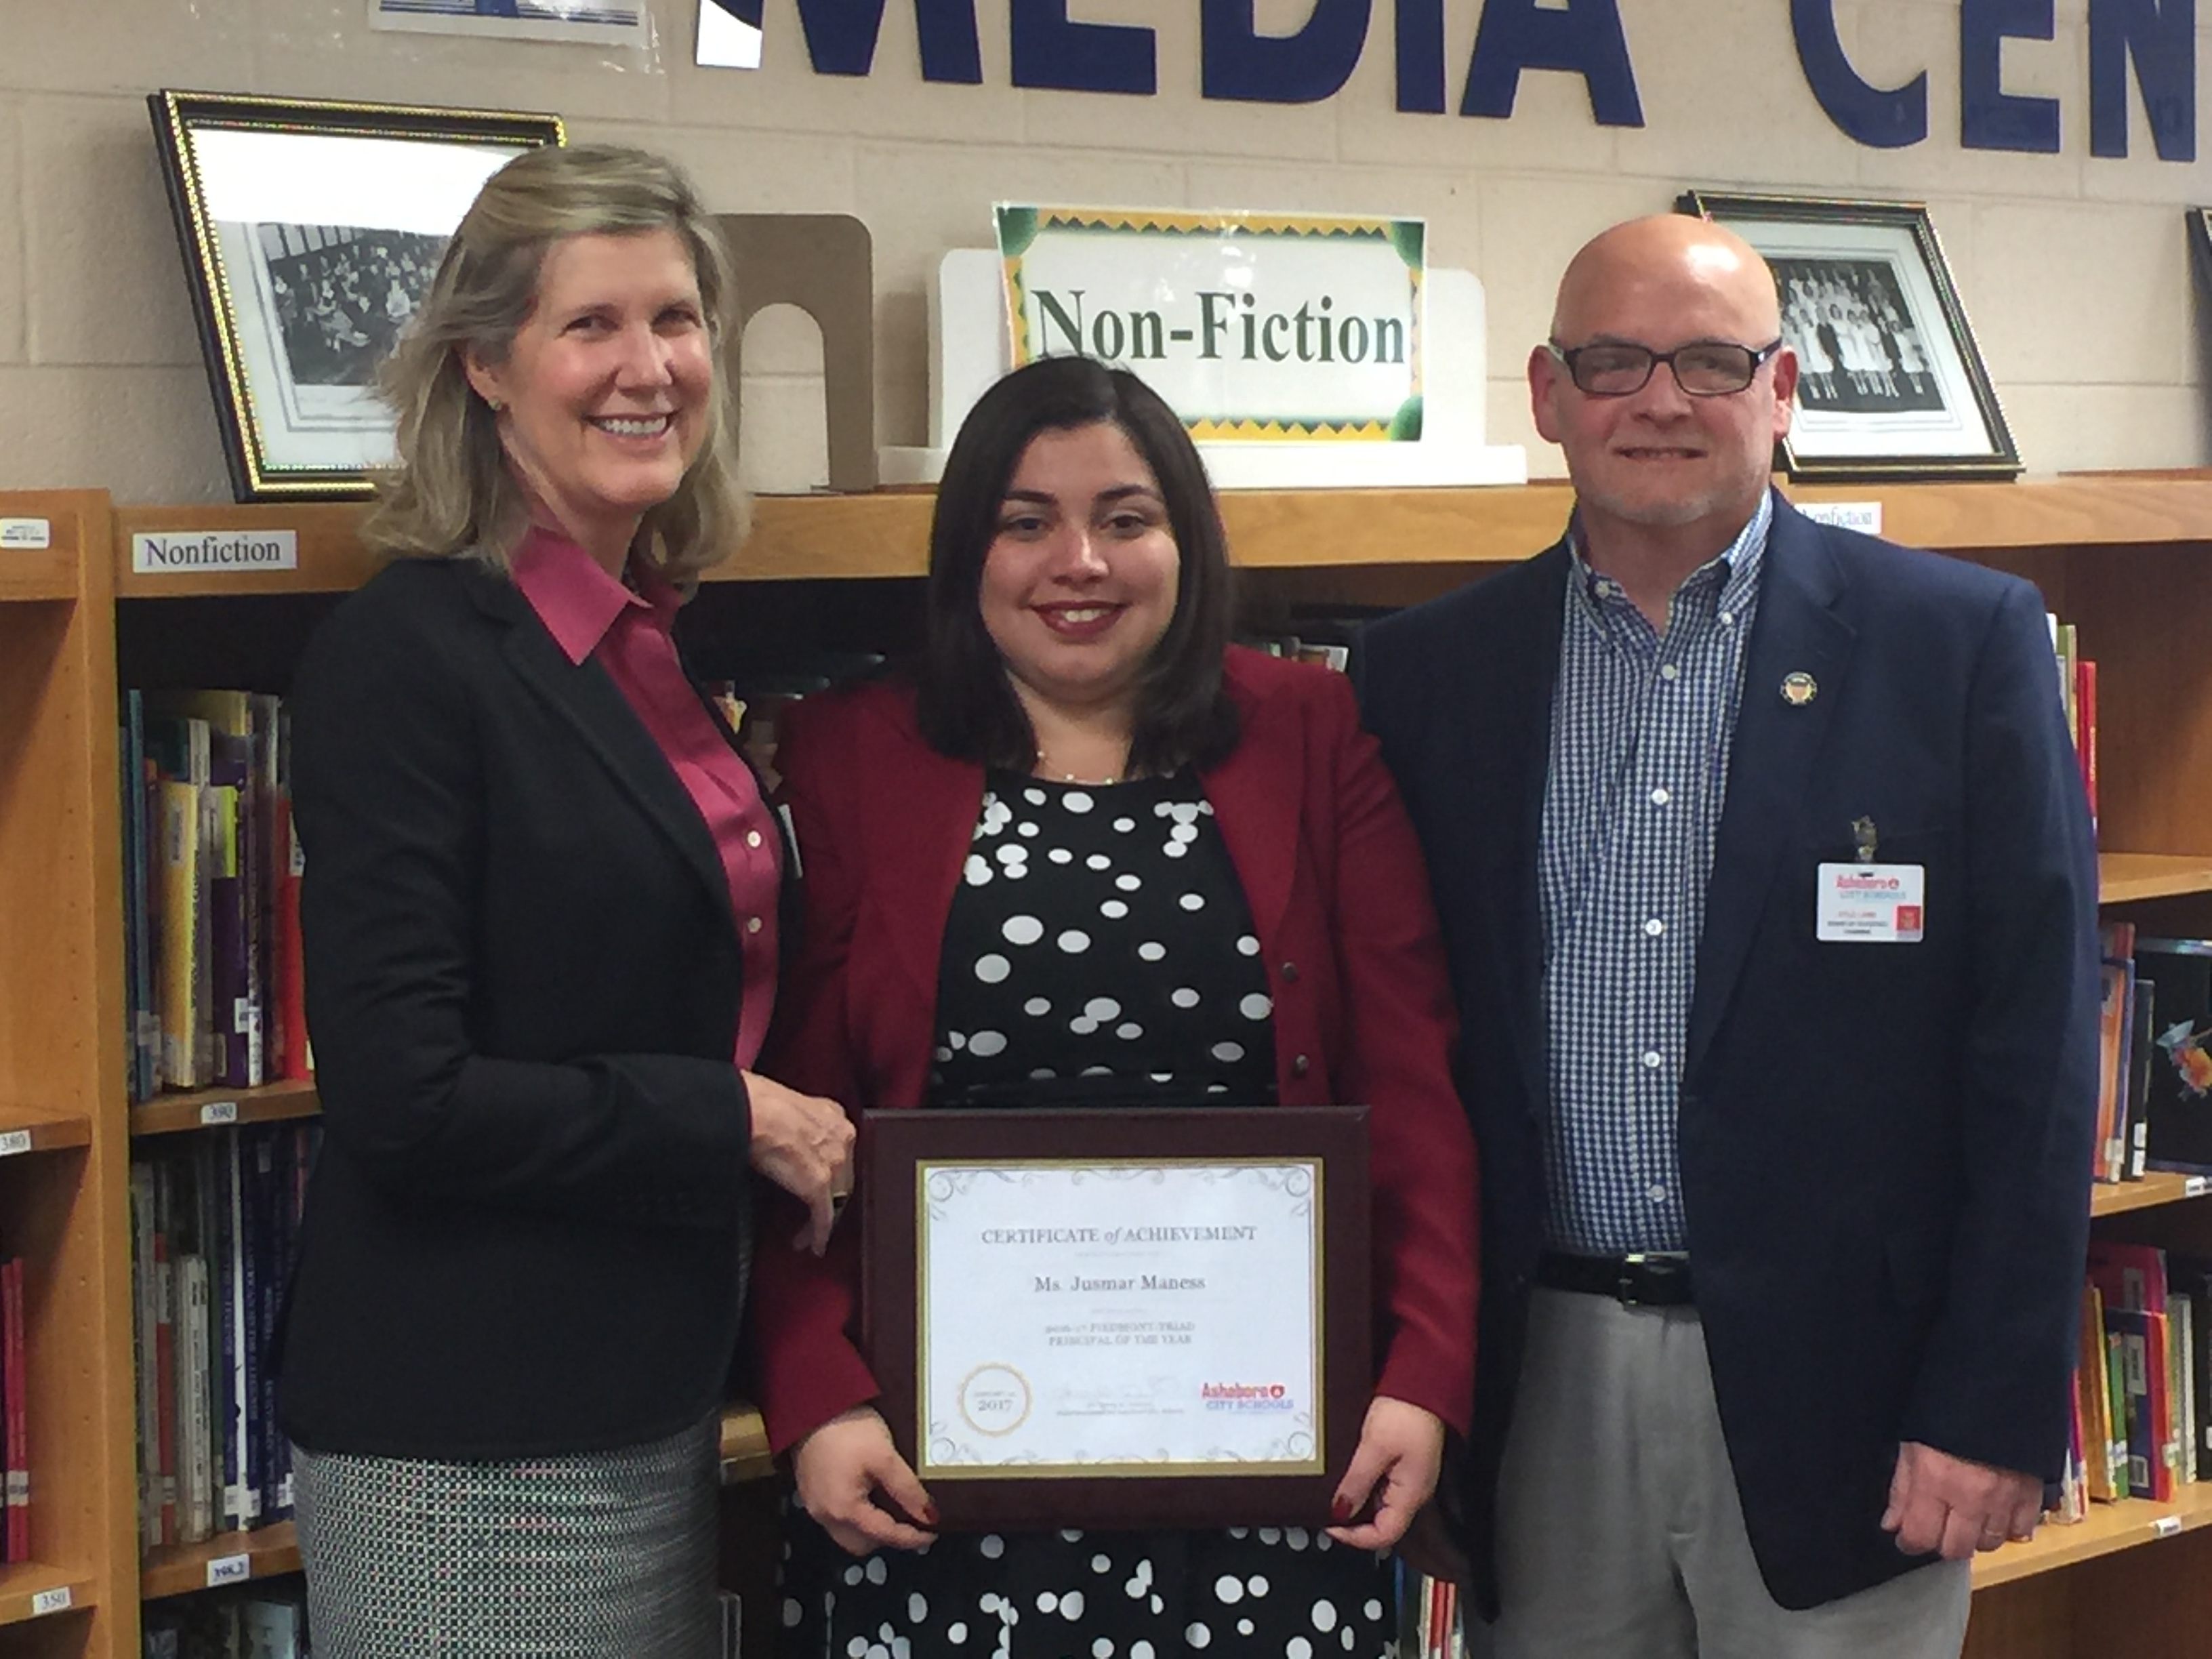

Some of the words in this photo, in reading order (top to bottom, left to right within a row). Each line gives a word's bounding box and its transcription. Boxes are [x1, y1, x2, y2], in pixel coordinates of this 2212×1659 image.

[1030, 289, 1405, 363] Non-Fiction
[144, 535, 280, 566] Nonfiction
[982, 1228, 1099, 1244] CERTIFICATE
[1105, 1227, 1122, 1245] of
[1124, 1226, 1257, 1242] ACHIEVEMENT
[1071, 1275, 1136, 1292] Jusmar
[1141, 1274, 1206, 1290] Maness
[978, 1399, 1014, 1412] 2017
